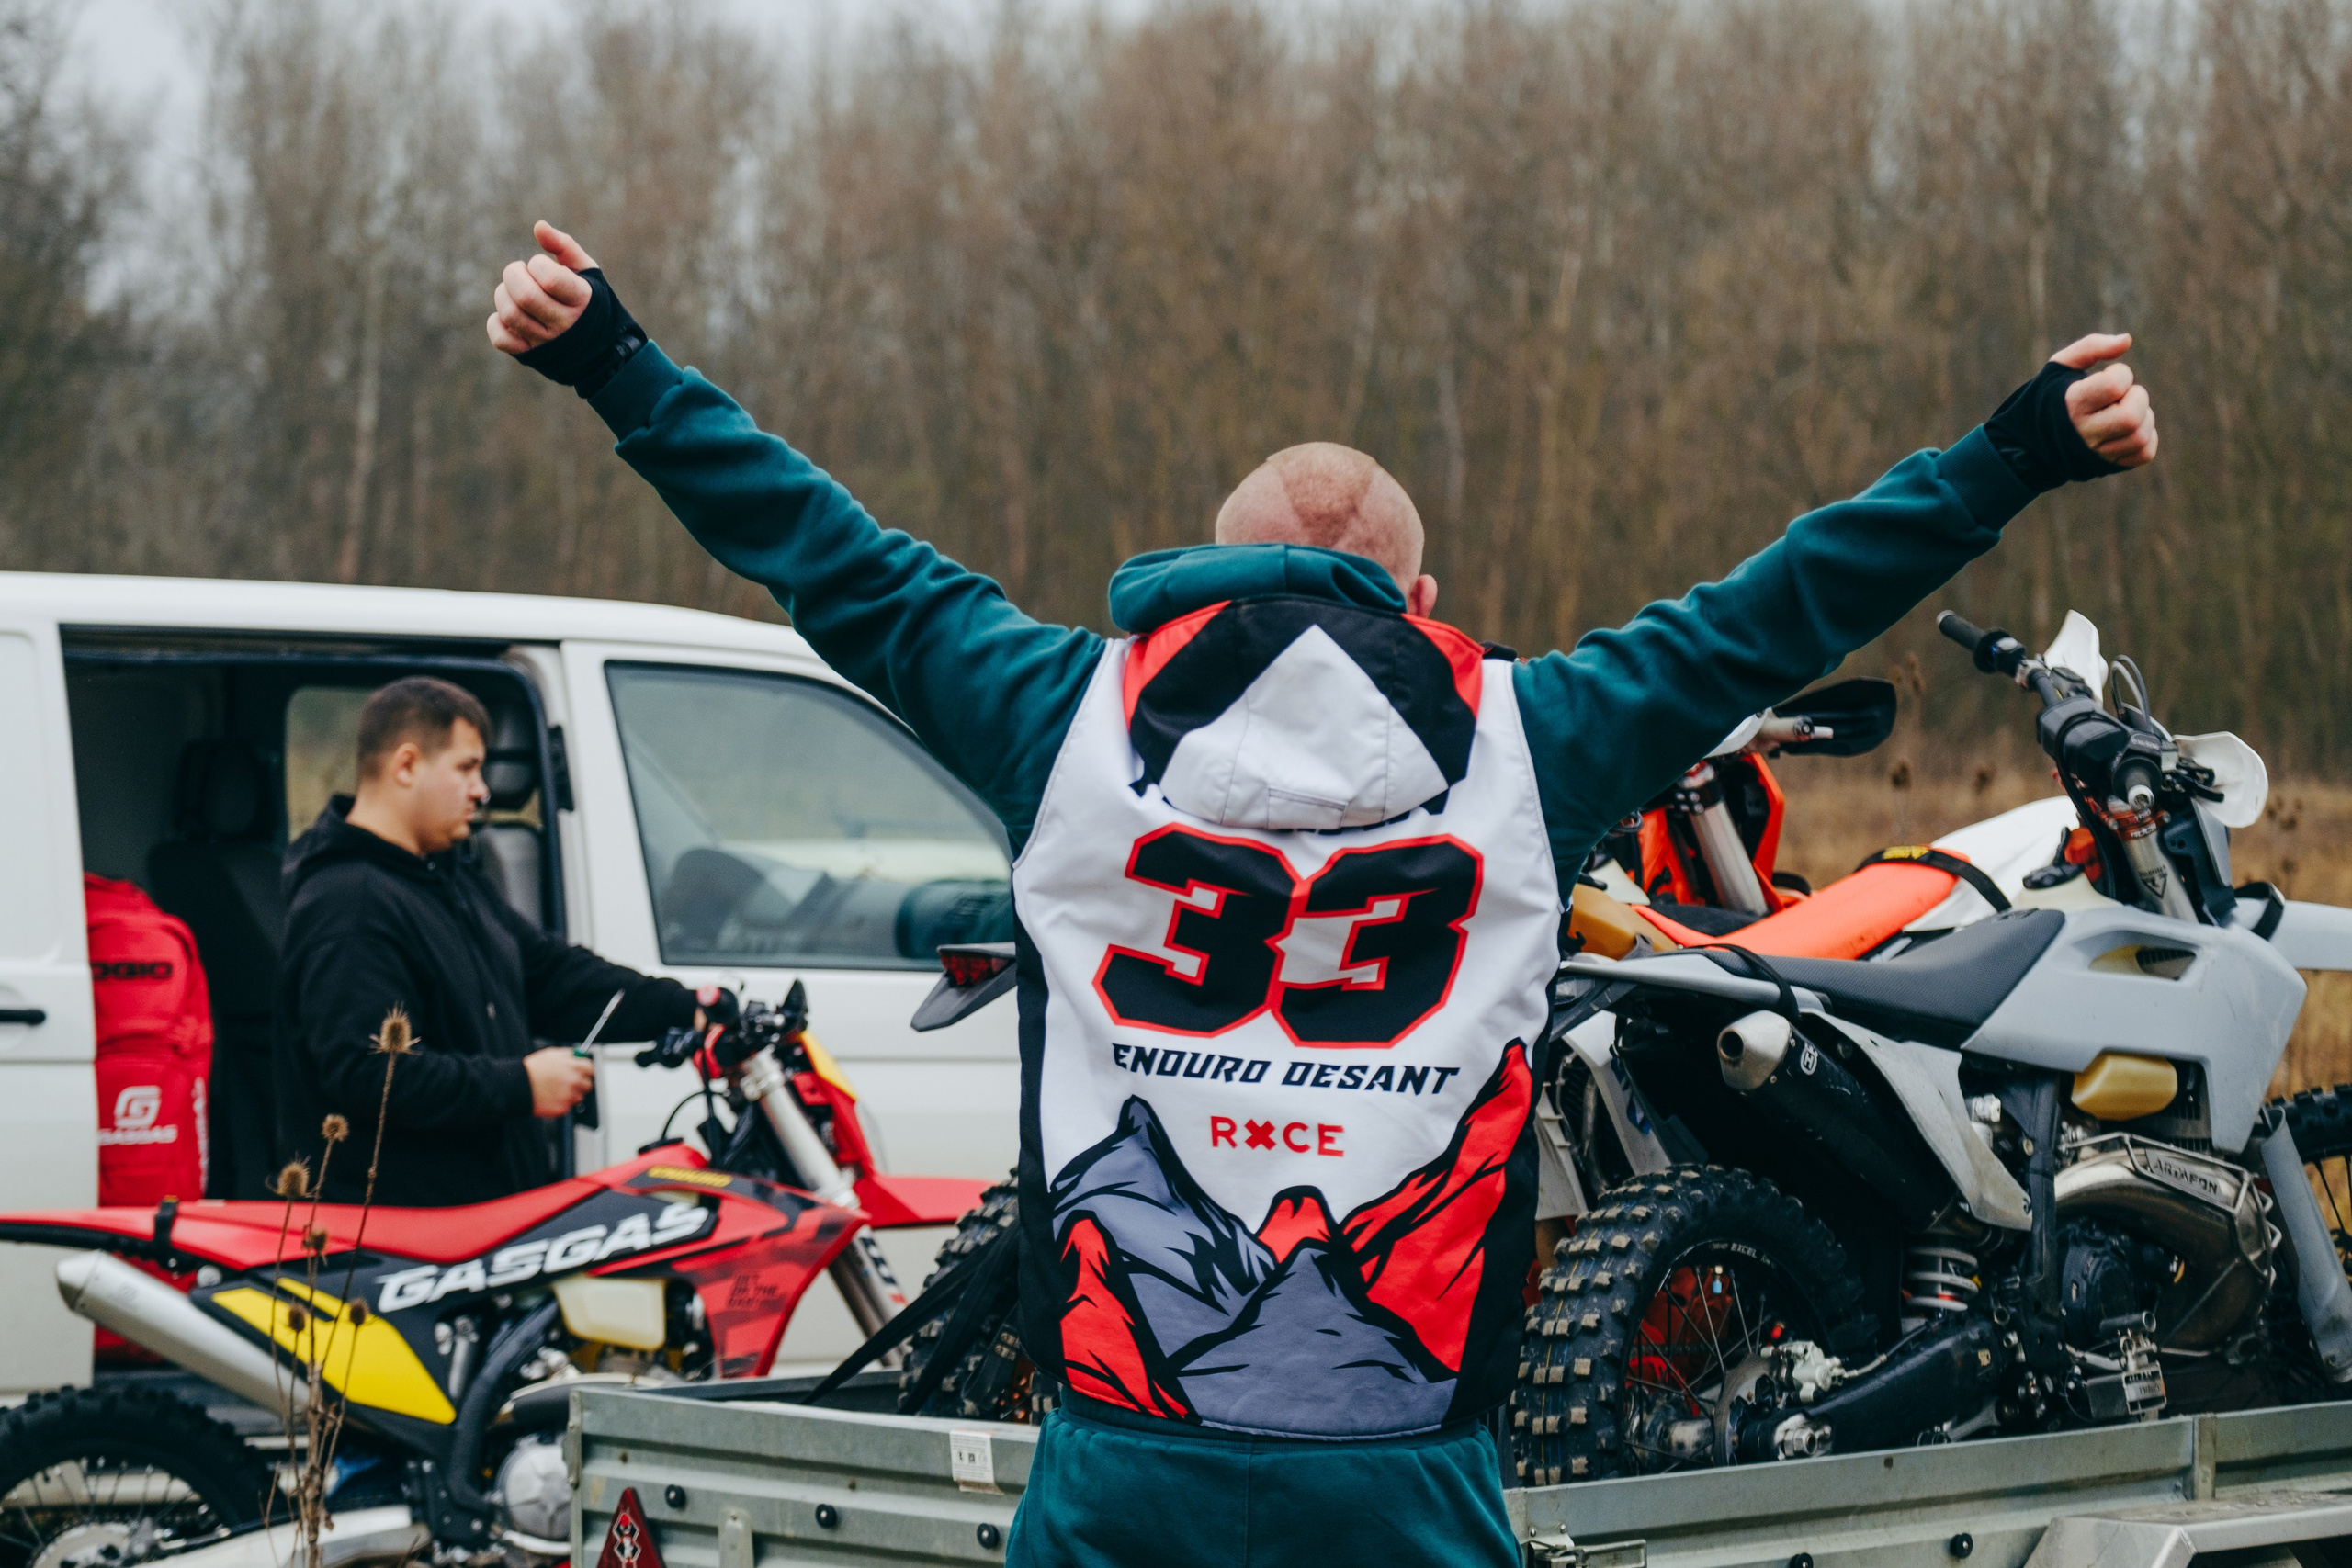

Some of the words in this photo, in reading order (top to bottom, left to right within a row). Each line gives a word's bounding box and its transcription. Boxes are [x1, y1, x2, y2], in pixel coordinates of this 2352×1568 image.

[1092, 822, 1484, 1049] 33
[1112, 1043, 1272, 1084] ENDURO
[1281, 1060, 1461, 1097] DESANT
[375, 1201, 710, 1314] GASGAS
[1730, 1242, 1758, 1259] EXCEL
